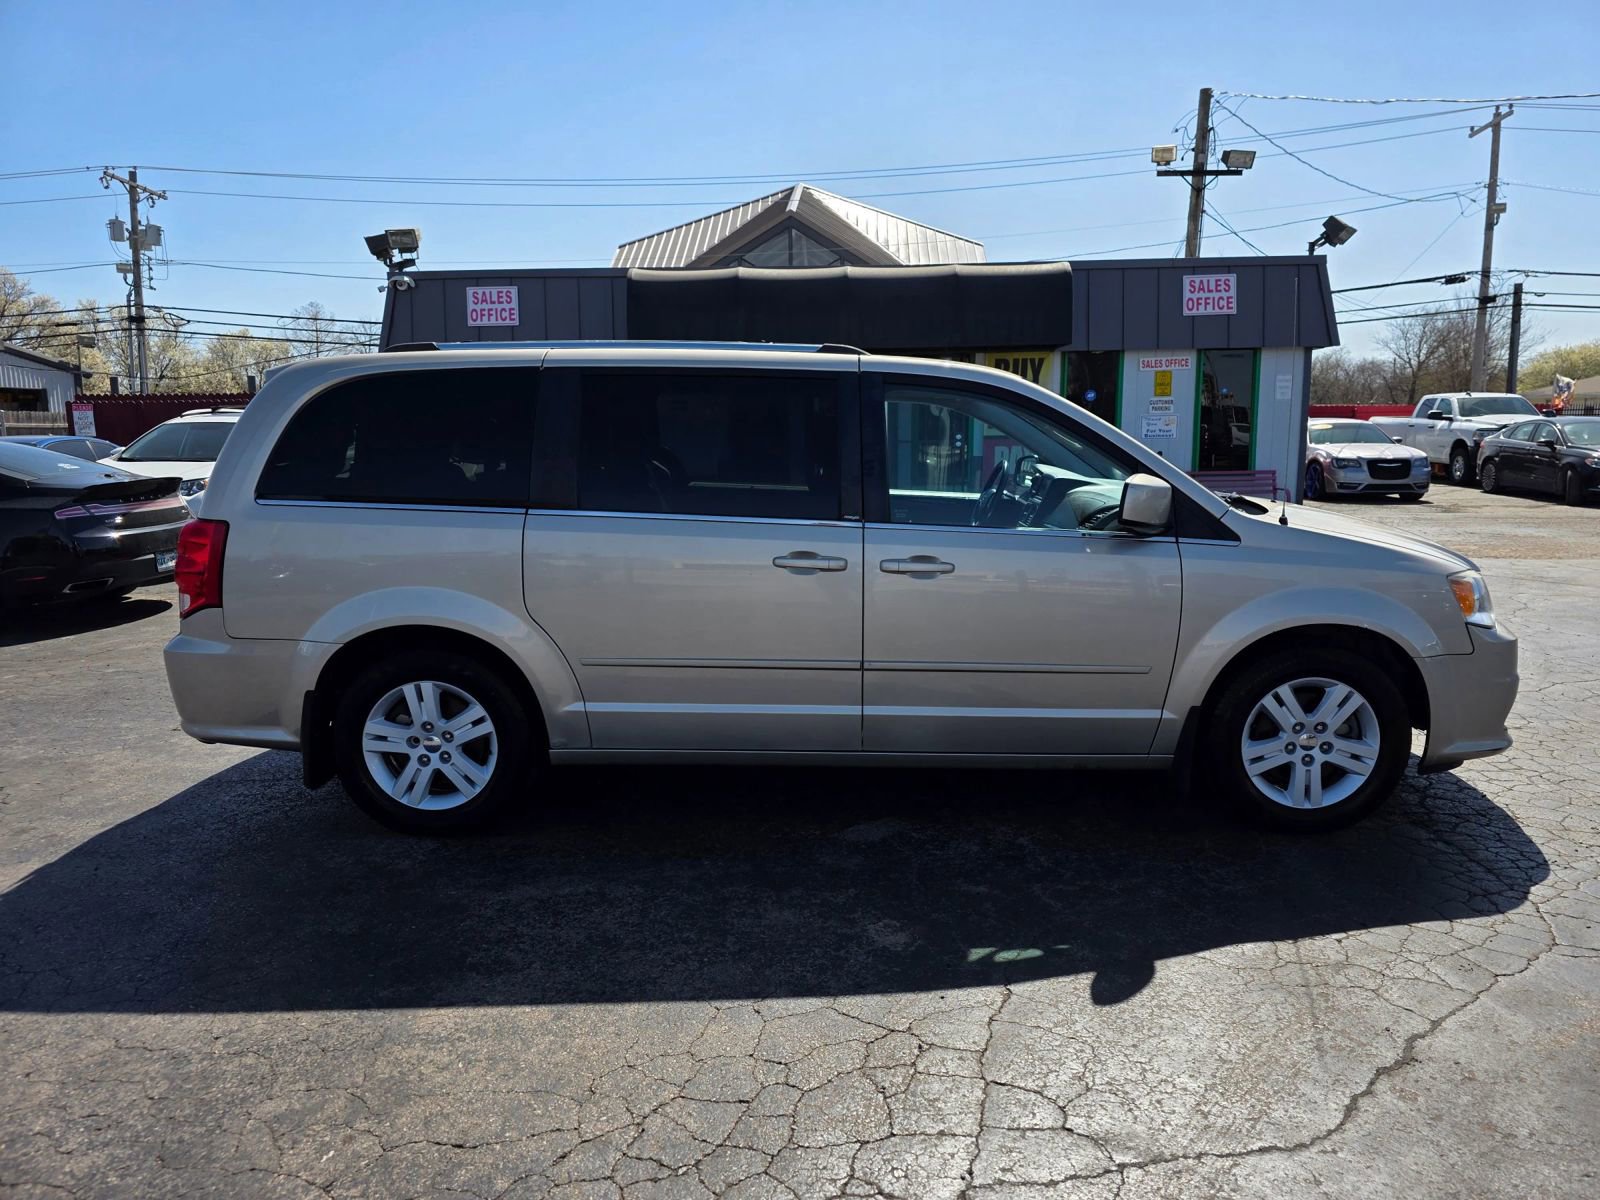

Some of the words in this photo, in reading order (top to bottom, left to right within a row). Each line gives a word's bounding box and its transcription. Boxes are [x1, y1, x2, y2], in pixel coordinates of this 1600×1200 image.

[1188, 278, 1231, 294] SALES
[472, 290, 513, 305] SALES
[1186, 296, 1234, 312] OFFICE
[470, 308, 516, 322] OFFICE
[1141, 359, 1163, 368] SALES
[1165, 358, 1189, 367] OFFICE
[994, 446, 1031, 474] PA
